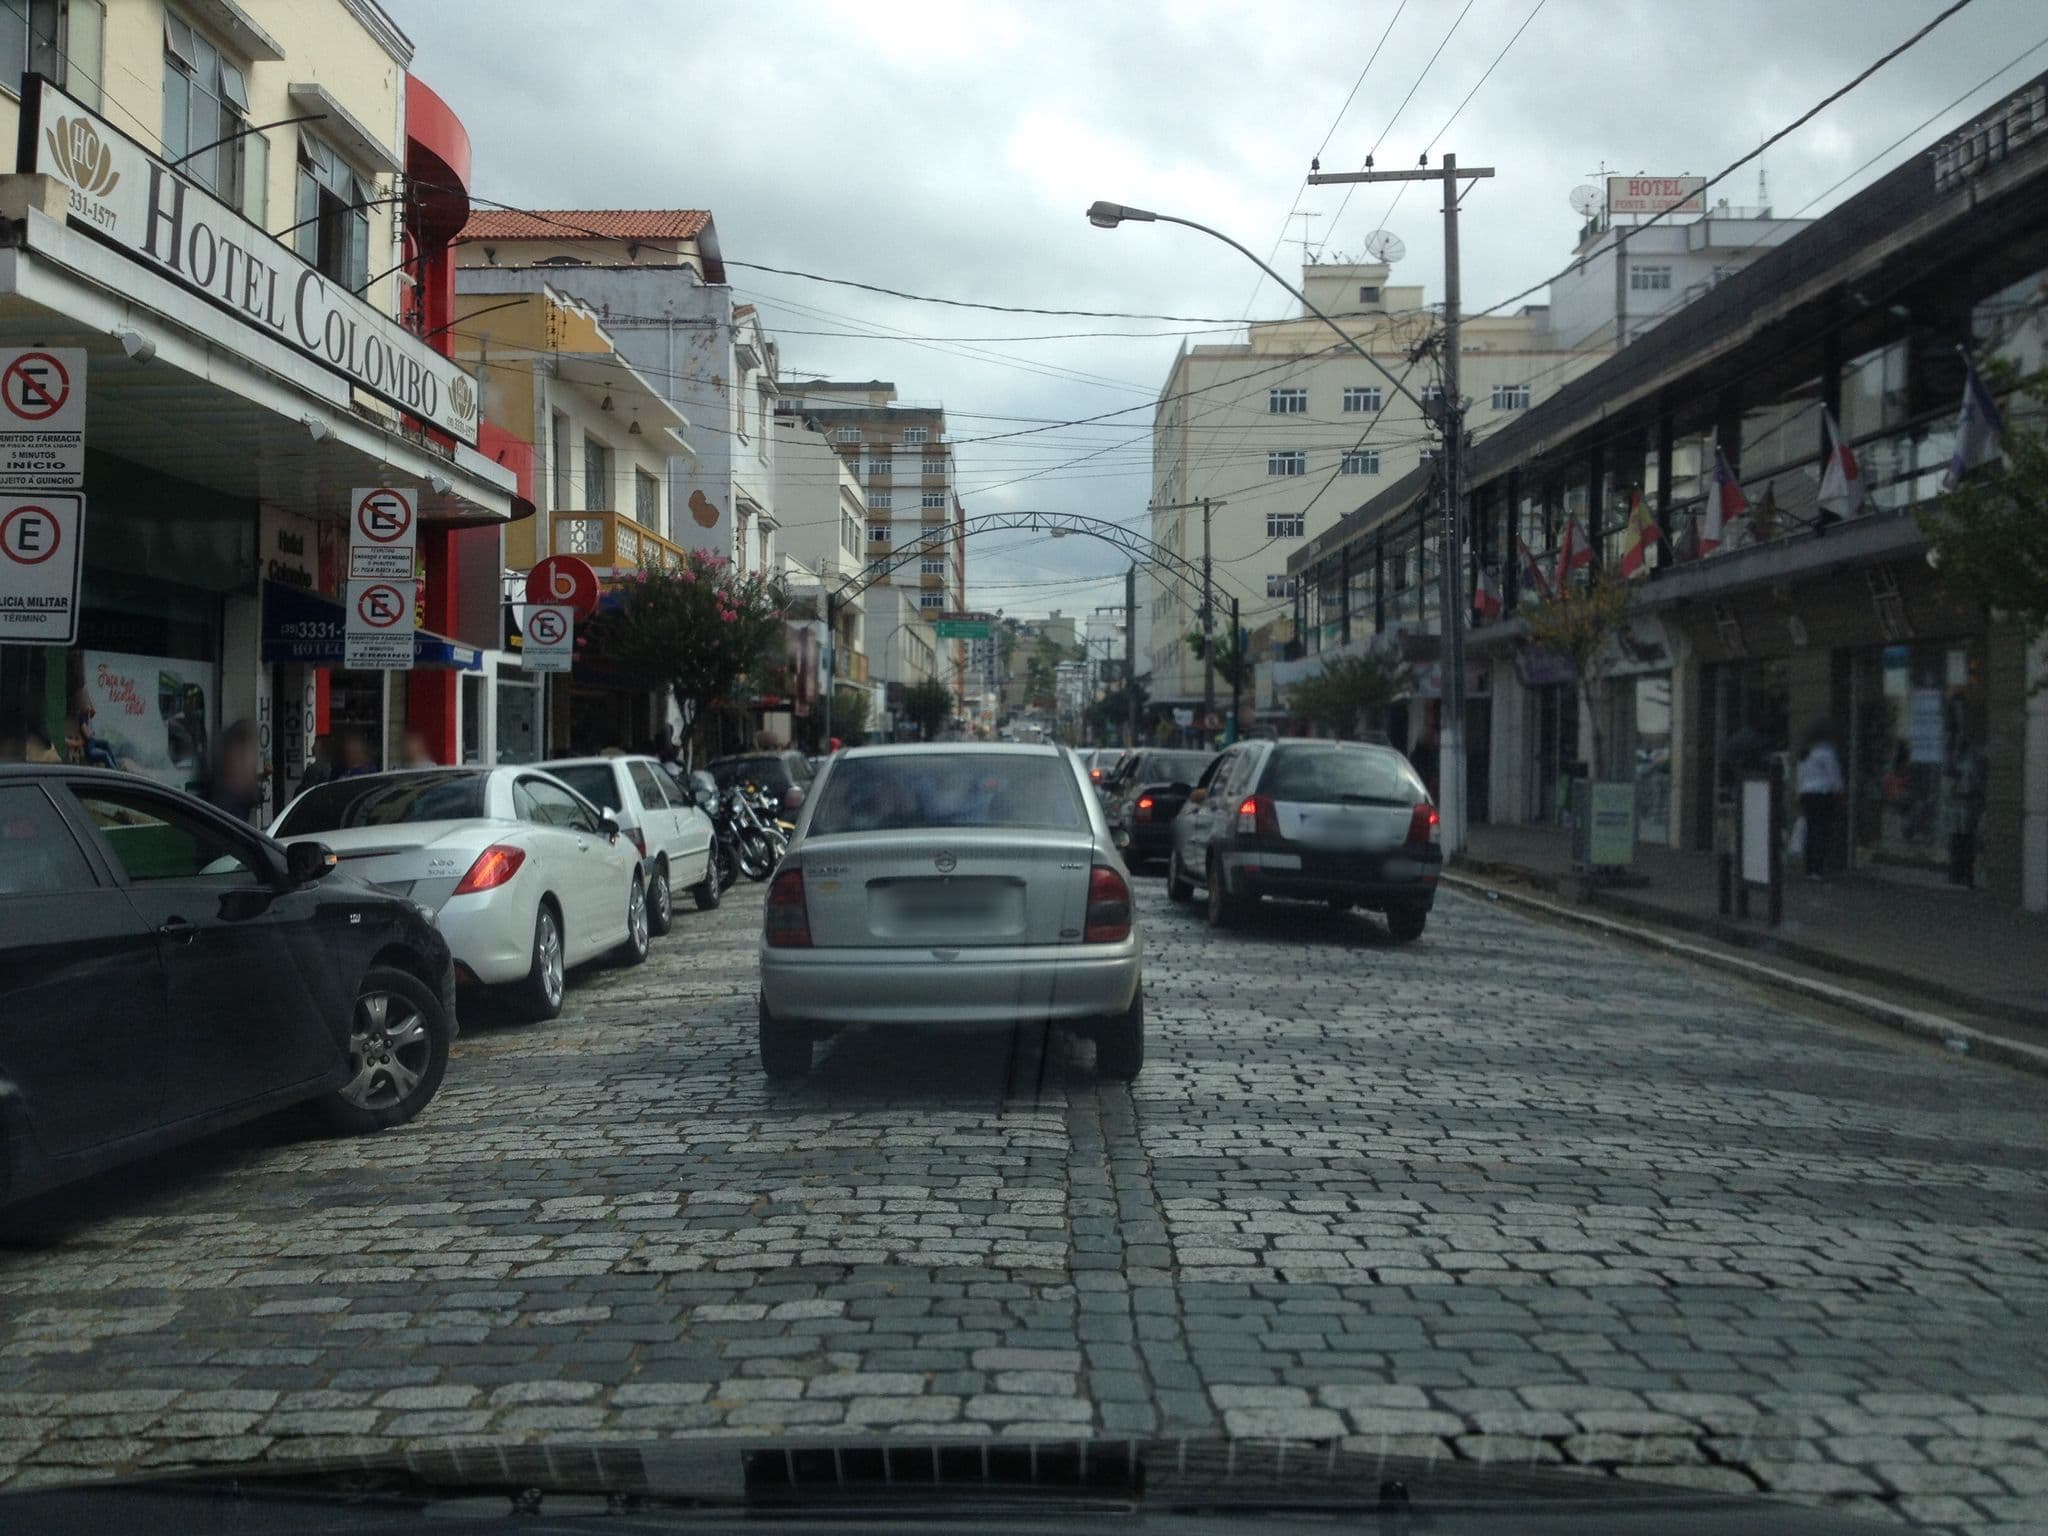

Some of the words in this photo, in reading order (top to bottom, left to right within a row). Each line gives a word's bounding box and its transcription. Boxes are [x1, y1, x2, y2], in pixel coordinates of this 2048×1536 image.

[72, 123, 96, 170] HC
[1629, 180, 1683, 196] HOTEL
[68, 187, 117, 231] 331-1577
[140, 158, 284, 332] HOTEL
[295, 268, 438, 418] COLOMBO
[11, 451, 17, 459] 5
[19, 451, 56, 459] MINUTOS
[36, 476, 75, 485] GUINCHO
[27, 596, 68, 608] MILITAR
